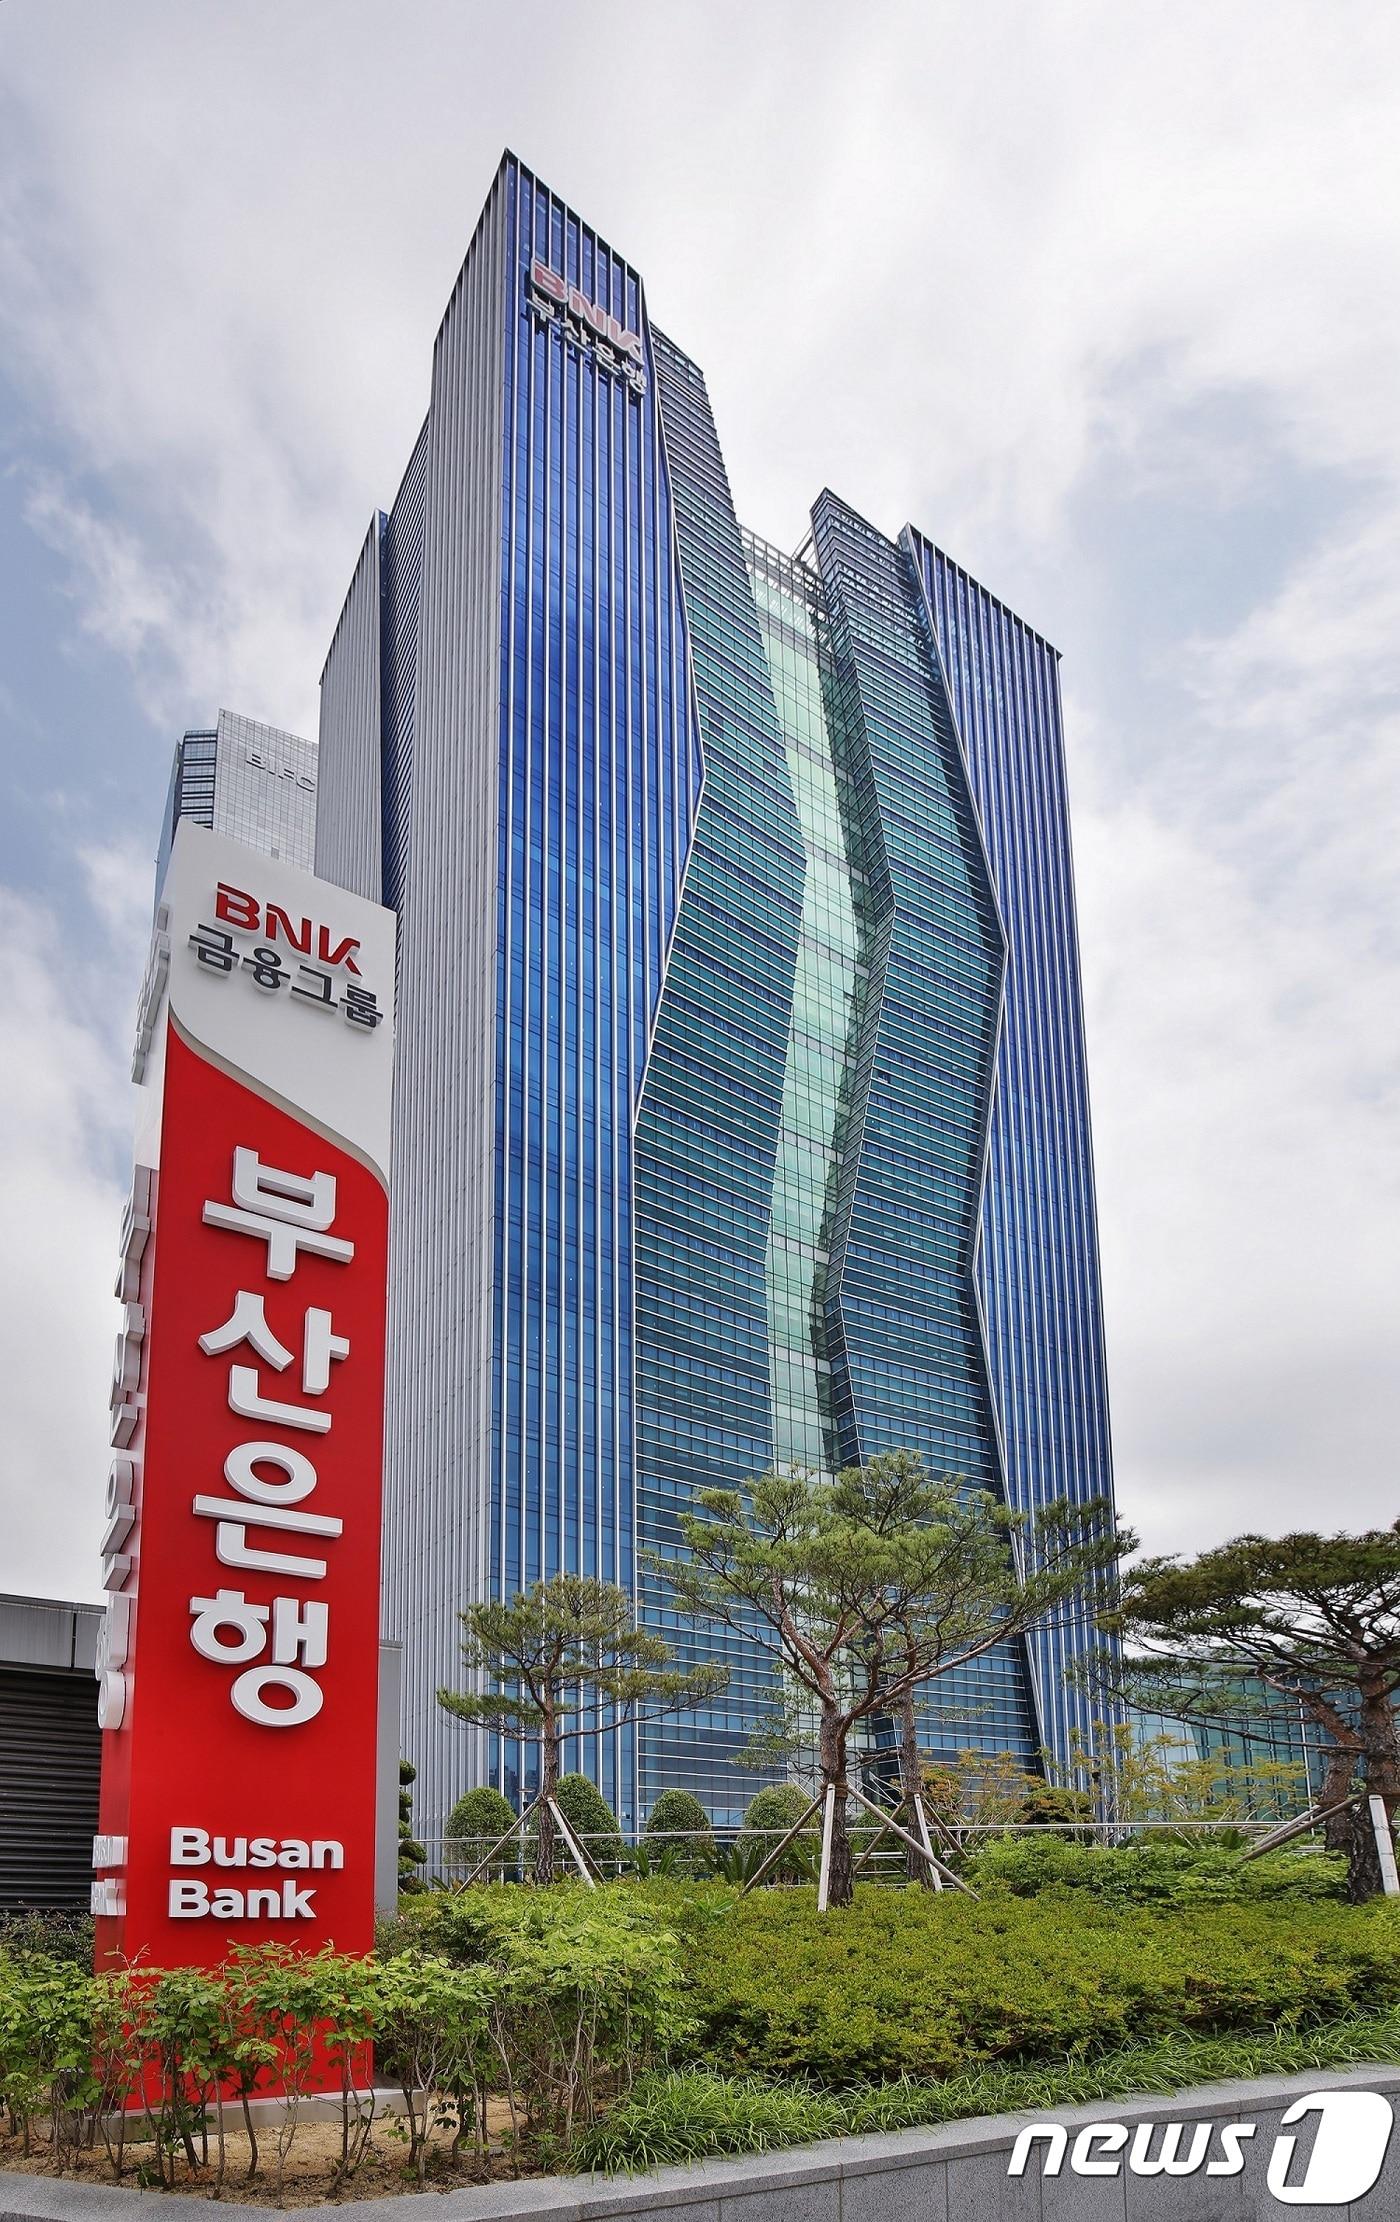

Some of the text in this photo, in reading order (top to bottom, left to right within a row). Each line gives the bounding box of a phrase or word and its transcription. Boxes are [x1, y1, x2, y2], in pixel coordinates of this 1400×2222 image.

[530, 257, 645, 368] BNK
[188, 923, 383, 1032] 금융그룹
[214, 881, 363, 978] BNK
[189, 1145, 355, 1727] 부산은행
[168, 1879, 318, 1919] Bank
[169, 1826, 345, 1870] Busan
